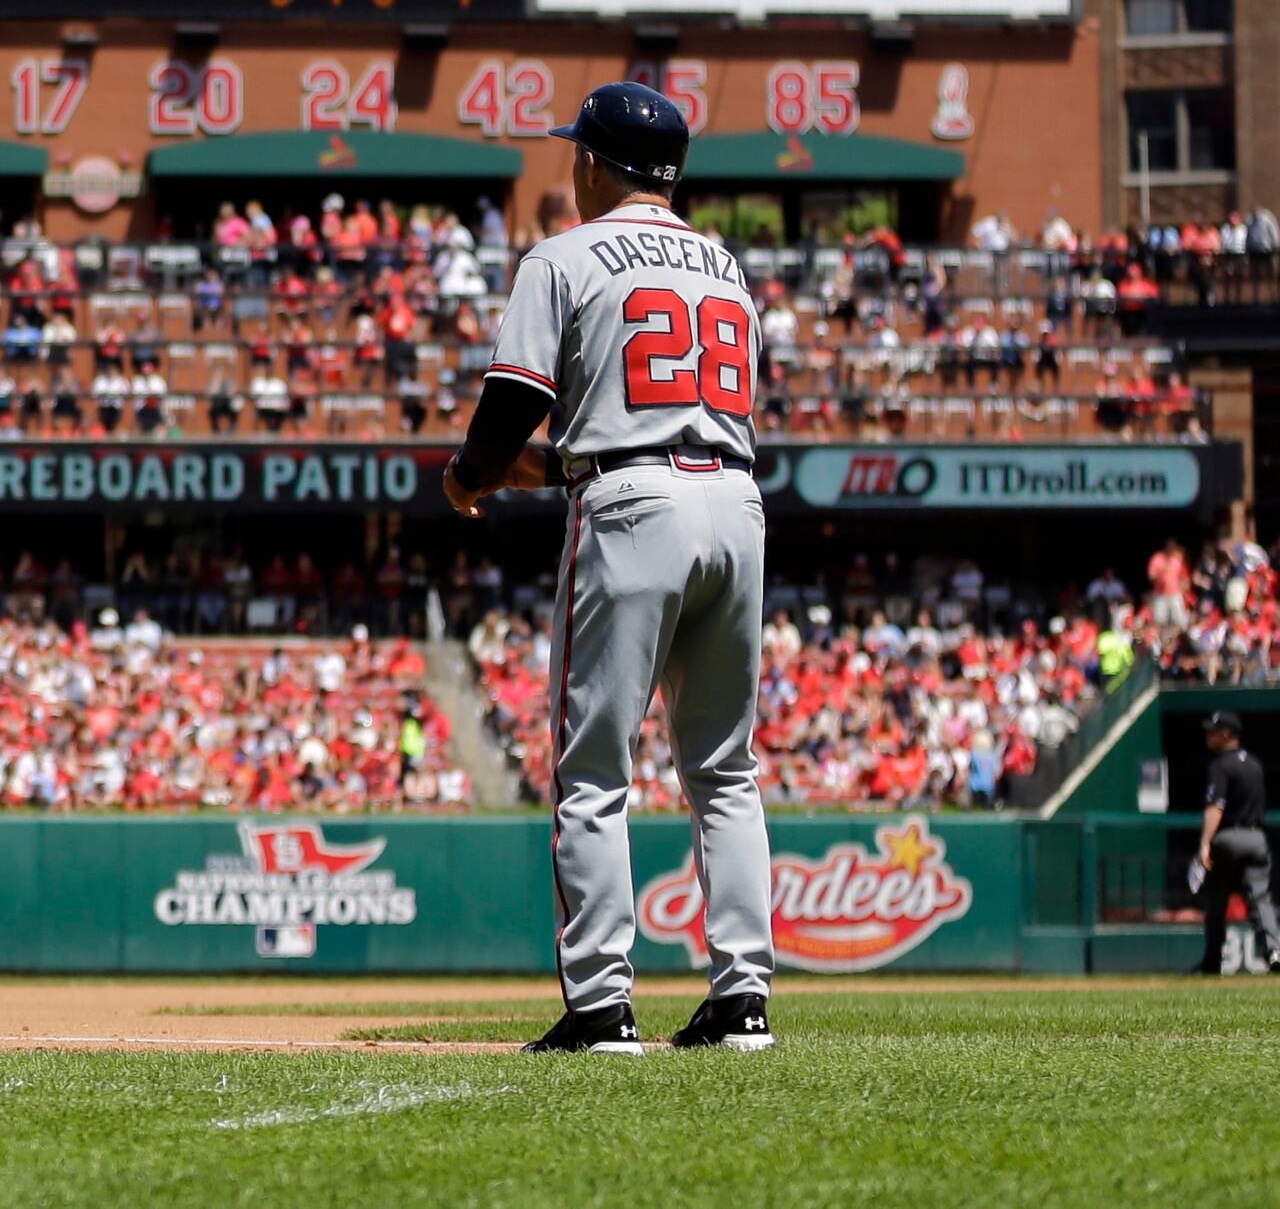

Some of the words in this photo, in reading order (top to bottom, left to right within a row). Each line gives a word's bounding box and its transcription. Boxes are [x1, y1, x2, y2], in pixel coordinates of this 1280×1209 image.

[11, 57, 89, 134] 17
[149, 58, 244, 136] 20
[301, 58, 399, 133] 24
[456, 59, 555, 137] 42
[627, 59, 709, 138] 5
[766, 60, 861, 137] 85
[662, 164, 678, 182] 28
[622, 287, 753, 419] 28
[263, 454, 417, 501] PATIO
[958, 460, 1167, 495] ITDroll.com
[154, 888, 417, 924] CHAMPIONS
